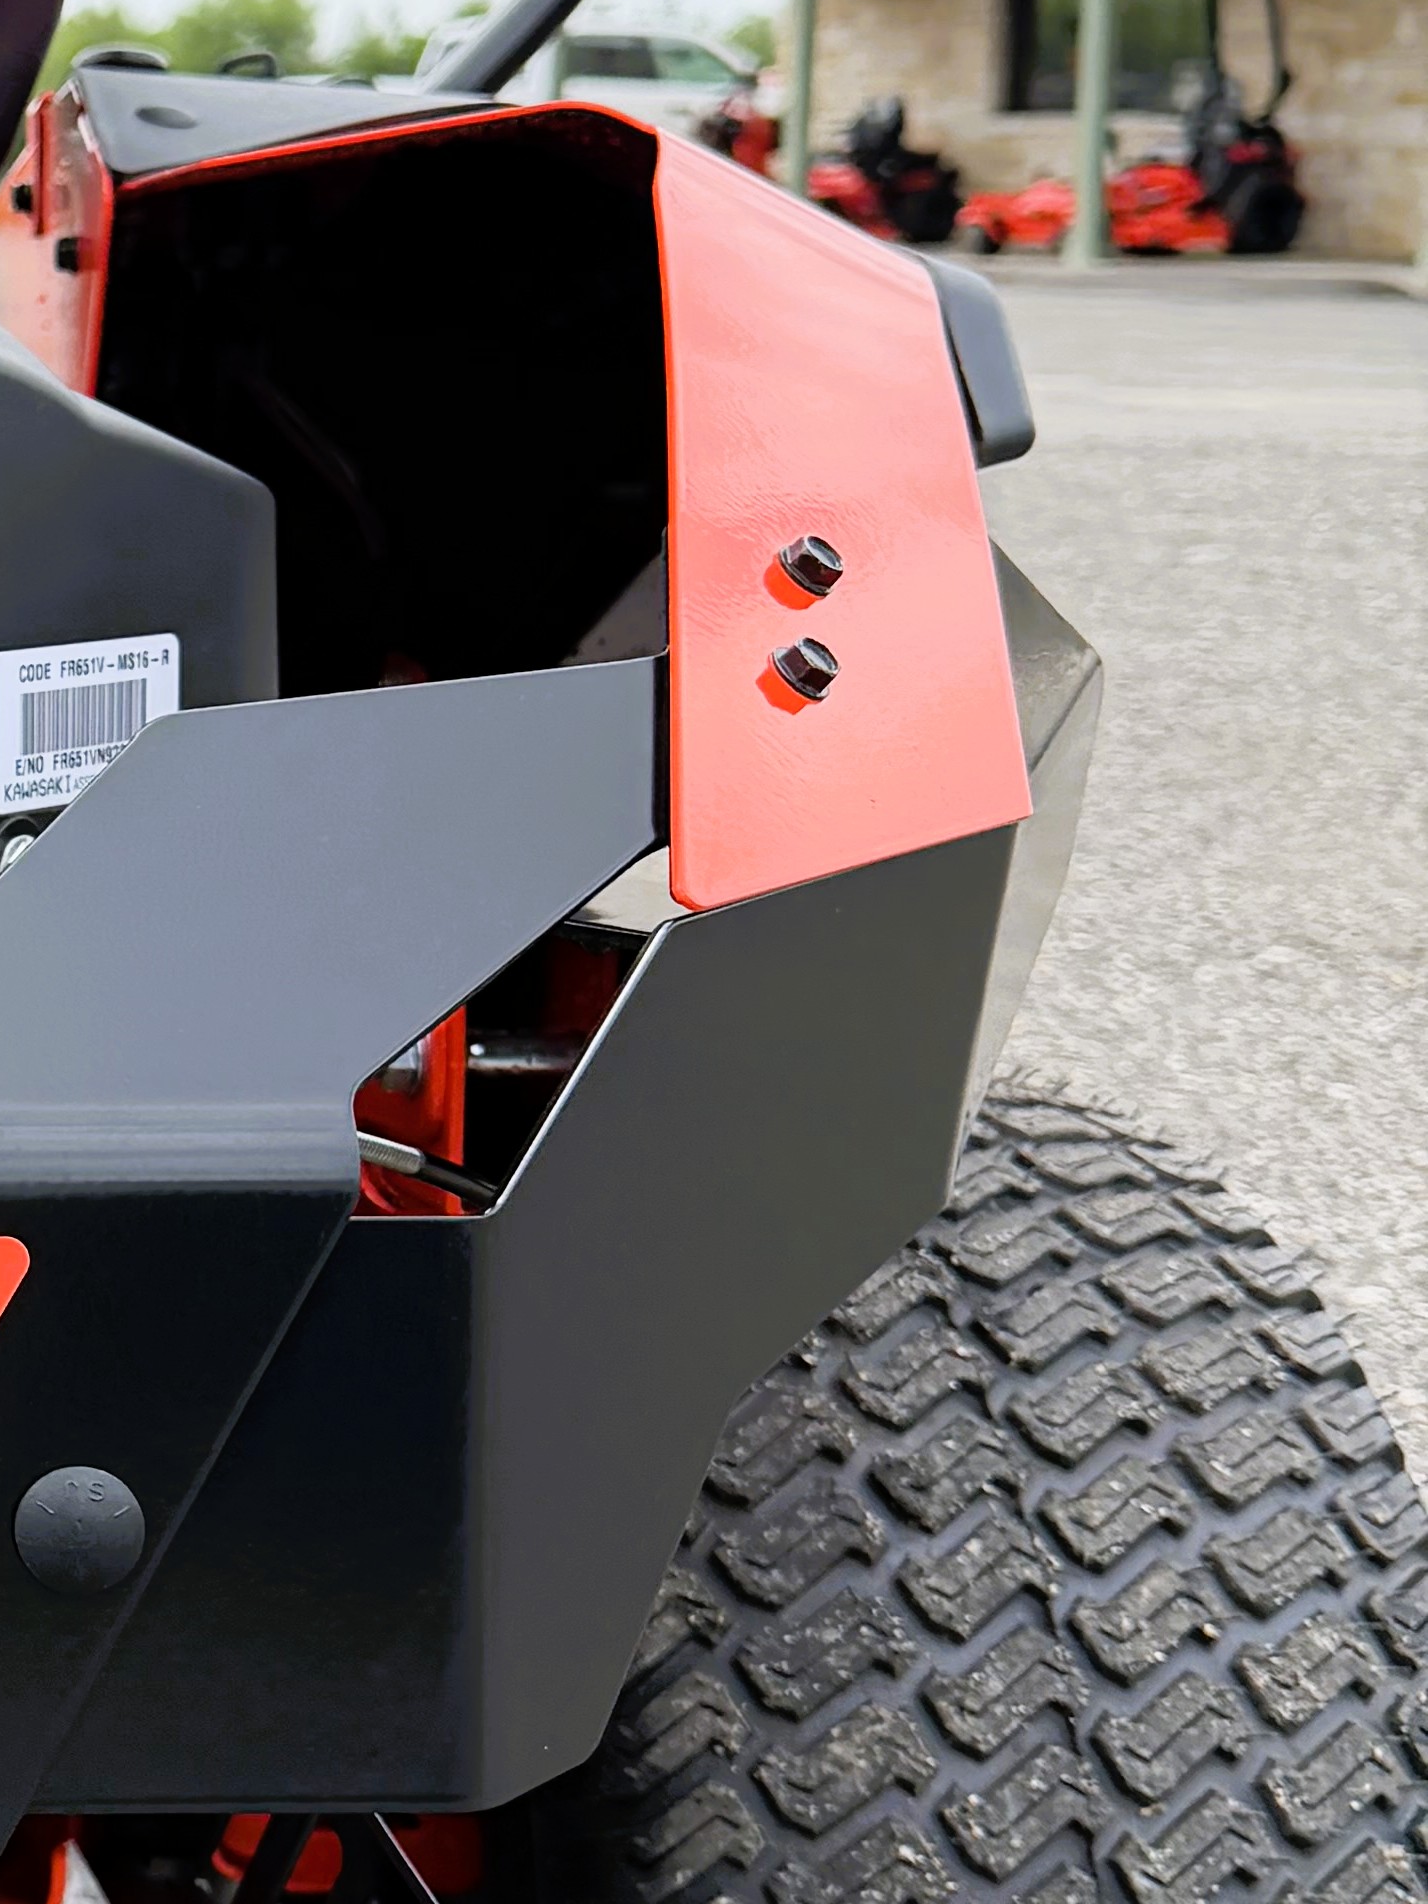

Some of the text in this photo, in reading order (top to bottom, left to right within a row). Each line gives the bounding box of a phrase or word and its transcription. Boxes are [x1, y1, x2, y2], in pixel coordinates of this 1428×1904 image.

[19, 663, 51, 683] CODE
[15, 756, 45, 776] E/NO
[4, 775, 72, 801] KAWASAKI
